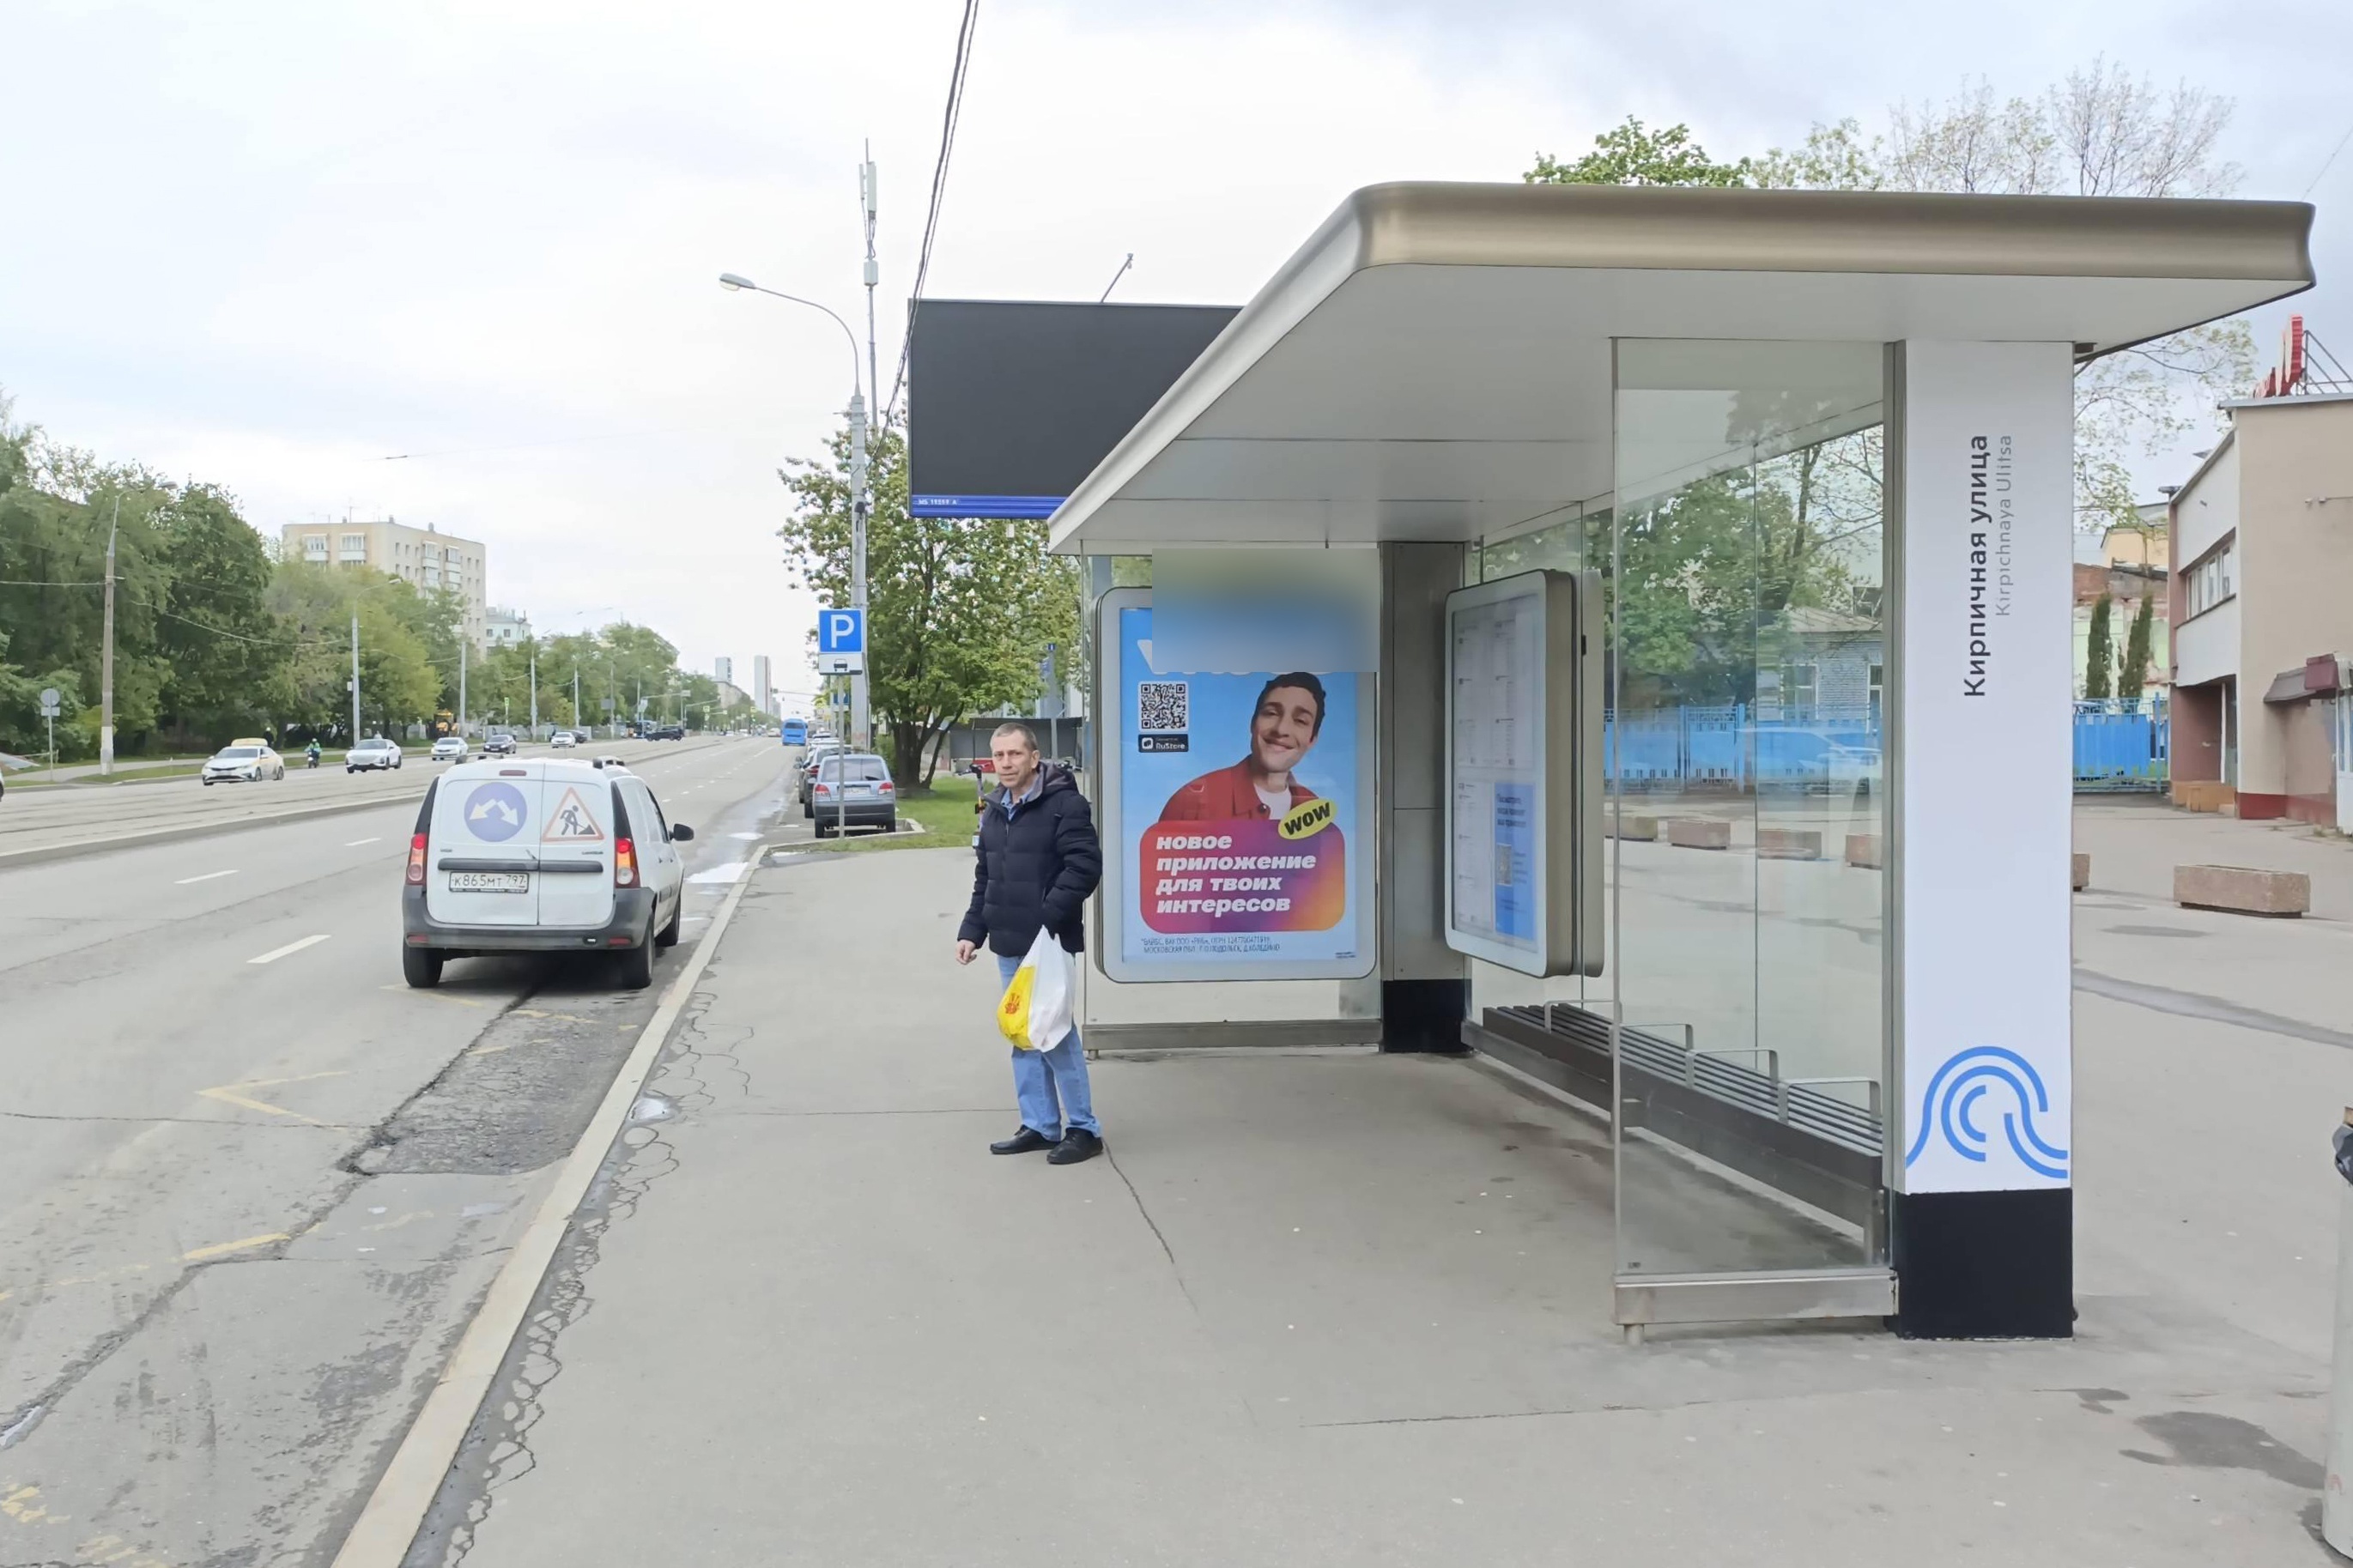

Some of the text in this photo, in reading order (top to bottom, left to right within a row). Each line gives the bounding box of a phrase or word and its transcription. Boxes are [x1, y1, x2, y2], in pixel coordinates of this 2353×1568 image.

[1996, 435, 2014, 616] Kirpichnaya Ulitsa
[1963, 435, 1992, 696] Кирпичная улица
[830, 614, 855, 649] P
[1155, 835, 1233, 851] новое
[1155, 855, 1317, 876] приложение
[1155, 877, 1283, 895] для твоих
[1156, 898, 1291, 917] интересов
